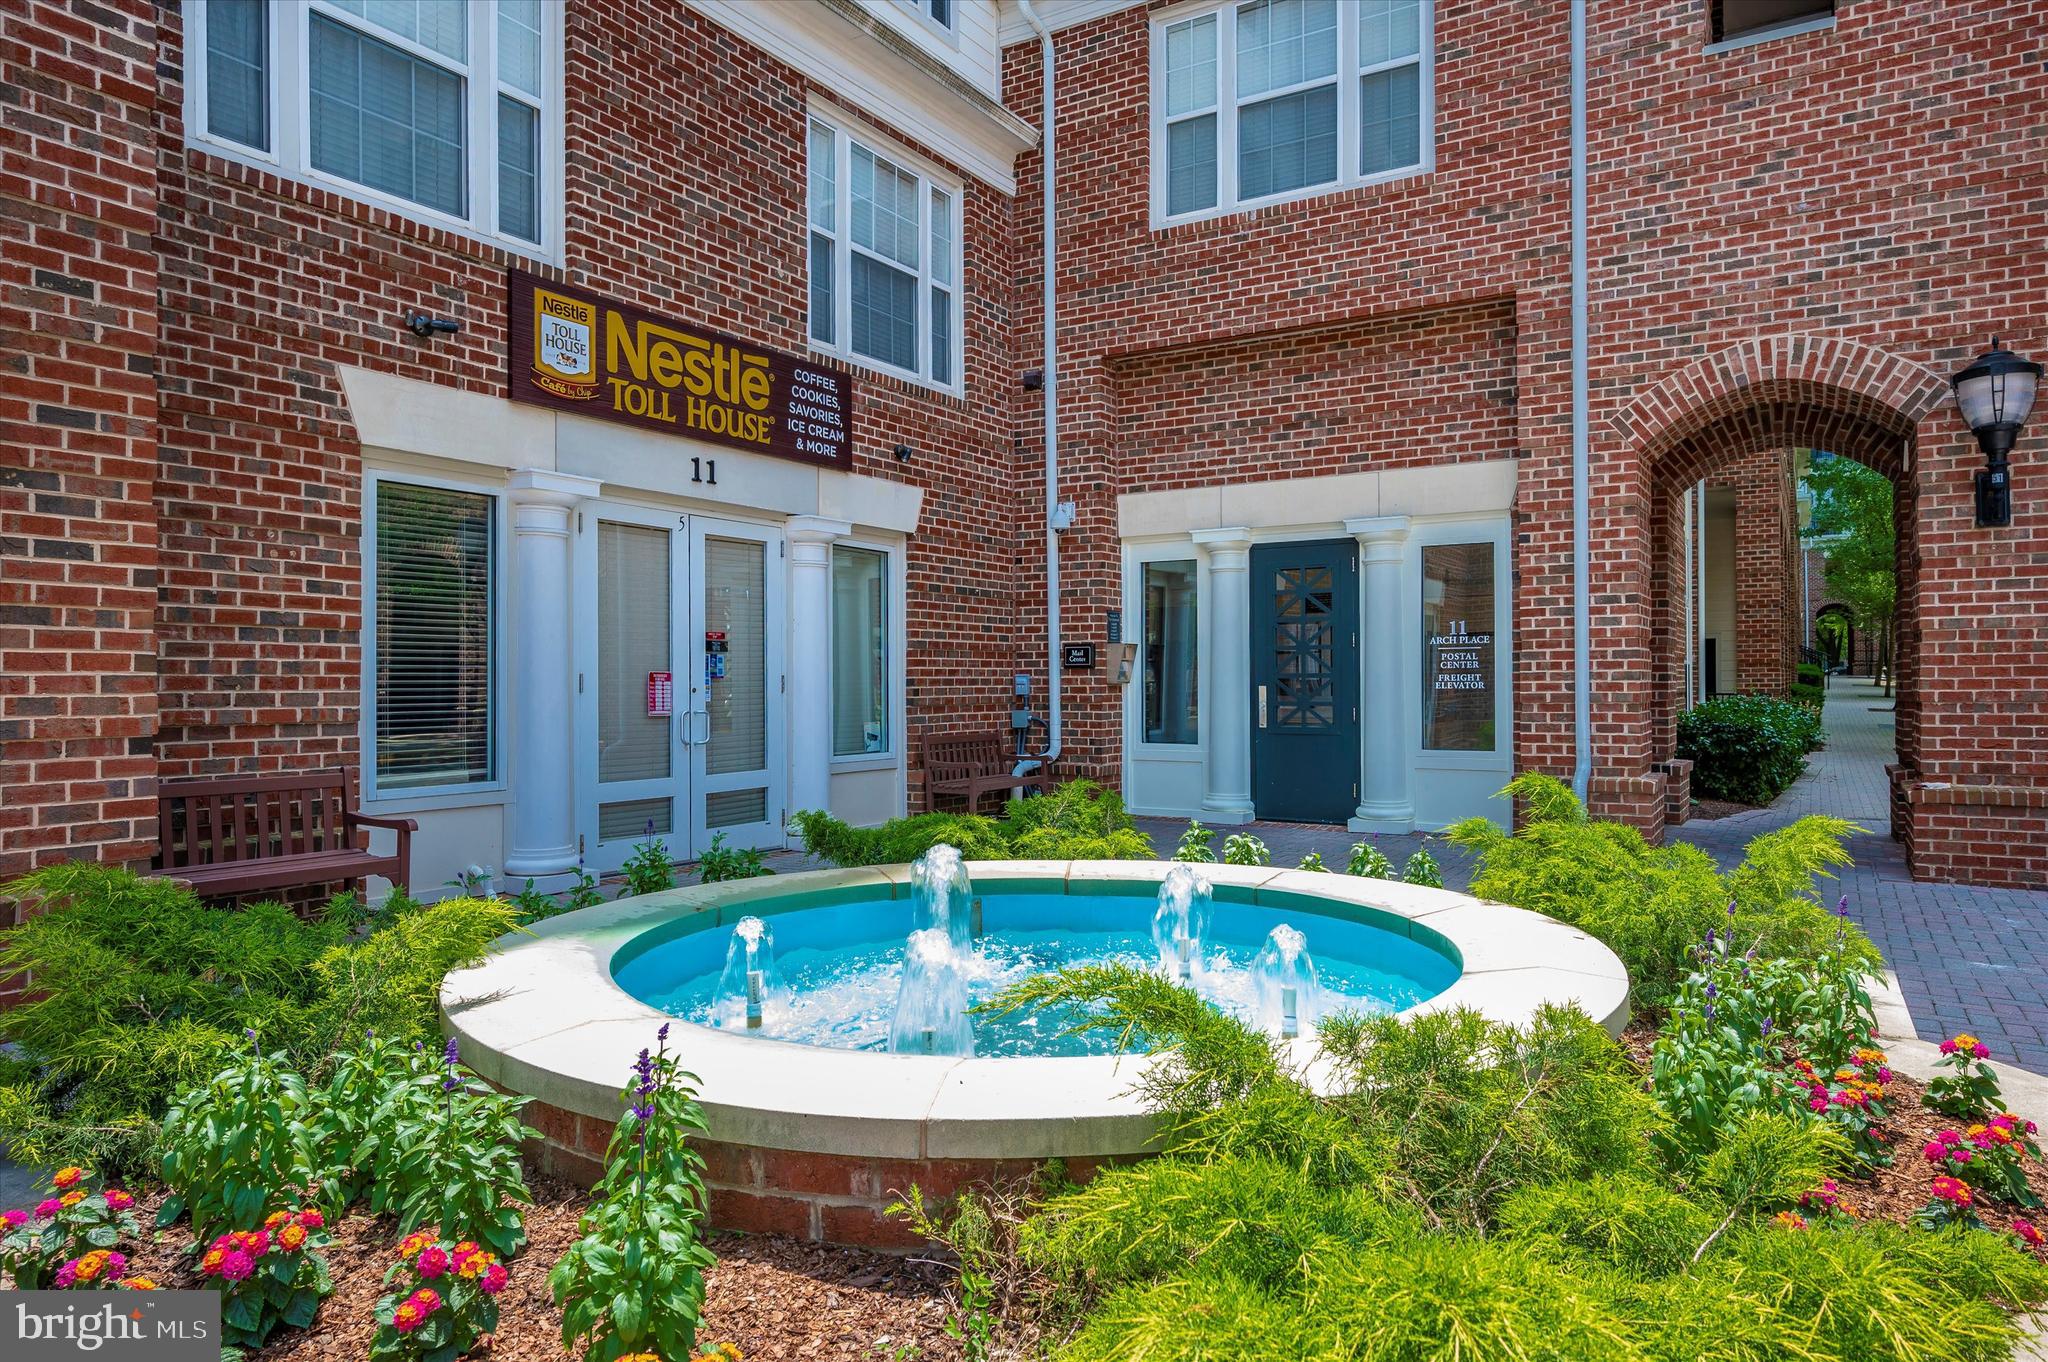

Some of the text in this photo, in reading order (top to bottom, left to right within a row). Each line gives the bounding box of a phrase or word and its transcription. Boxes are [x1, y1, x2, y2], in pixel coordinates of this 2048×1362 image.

[552, 323, 581, 342] TOLL
[545, 334, 587, 357] HOUSE
[541, 377, 592, 400] Café by Chip
[794, 369, 839, 394] COFFEE,
[791, 385, 841, 411] COOKIES,
[607, 377, 772, 445] TOLL HOUSE
[789, 402, 843, 428] SAVORIES,
[788, 418, 845, 443] ICE CREAM
[796, 438, 837, 458] & MORE
[691, 457, 717, 484] 11
[679, 516, 685, 531] 5
[1449, 620, 1467, 635] 11
[1430, 635, 1490, 645] ARCH PLACE
[1440, 661, 1480, 669] CENTER
[1441, 652, 1478, 660] POSTAL
[1435, 681, 1485, 690] ELEVATOR
[1438, 673, 1482, 682] FREIGHT
